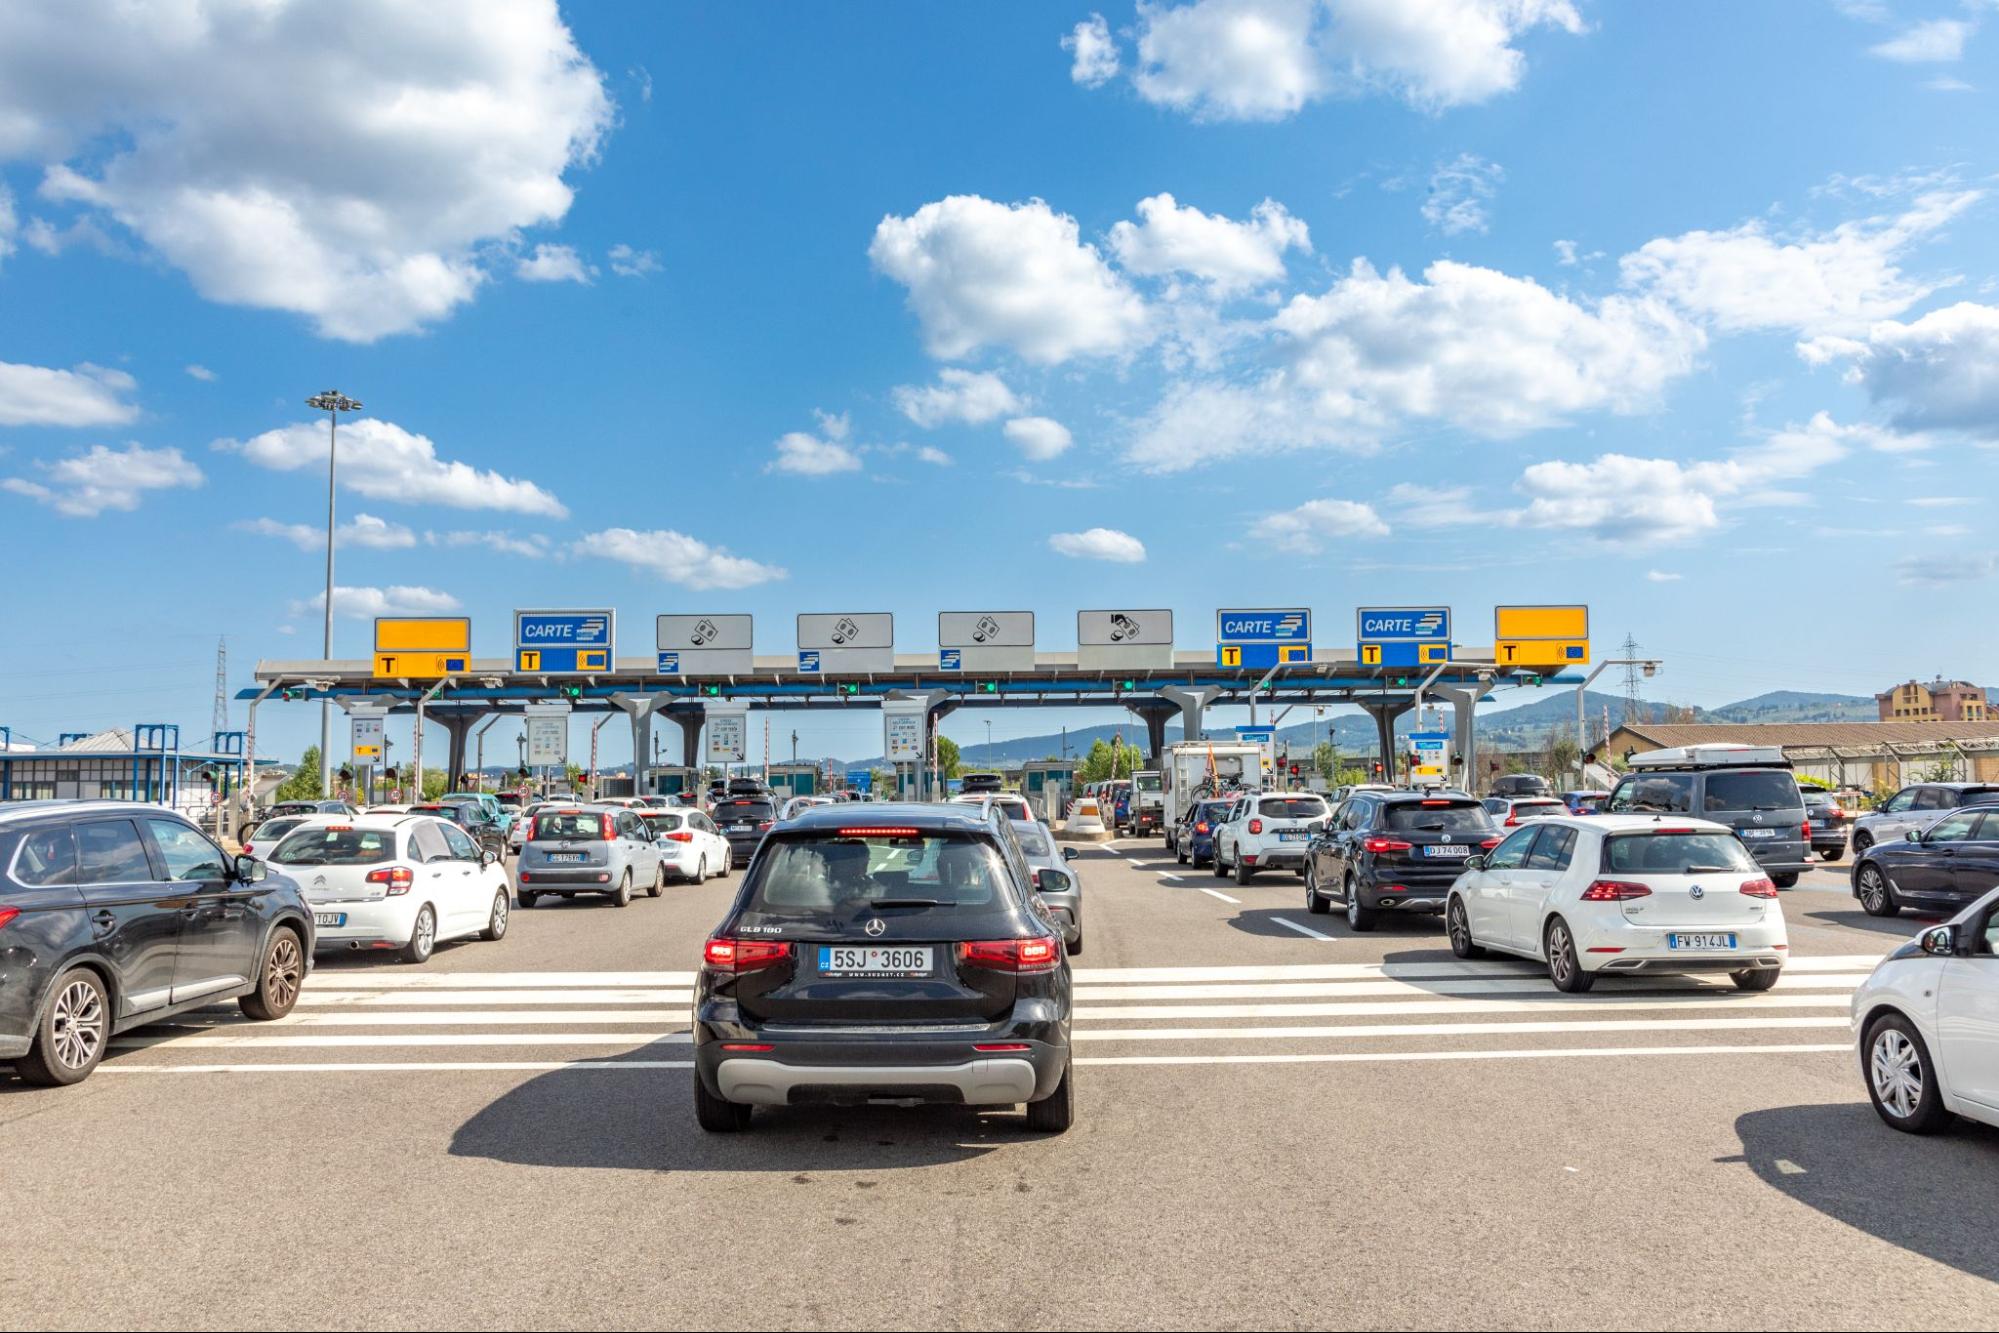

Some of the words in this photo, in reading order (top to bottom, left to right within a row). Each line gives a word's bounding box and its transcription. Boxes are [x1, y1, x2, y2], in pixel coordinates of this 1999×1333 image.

[525, 624, 573, 637] CARTE
[1225, 620, 1272, 634] CARTE
[1365, 619, 1412, 632] CARTE
[523, 652, 538, 669] T
[1224, 648, 1238, 665] T
[1364, 646, 1379, 663] T
[1503, 645, 1517, 661] T
[381, 657, 396, 673] T
[314, 914, 339, 924] 10JV
[1677, 935, 1691, 947] FW
[1695, 935, 1729, 947] 914JL
[834, 950, 867, 968] 5SJ
[880, 950, 924, 968] 3606
